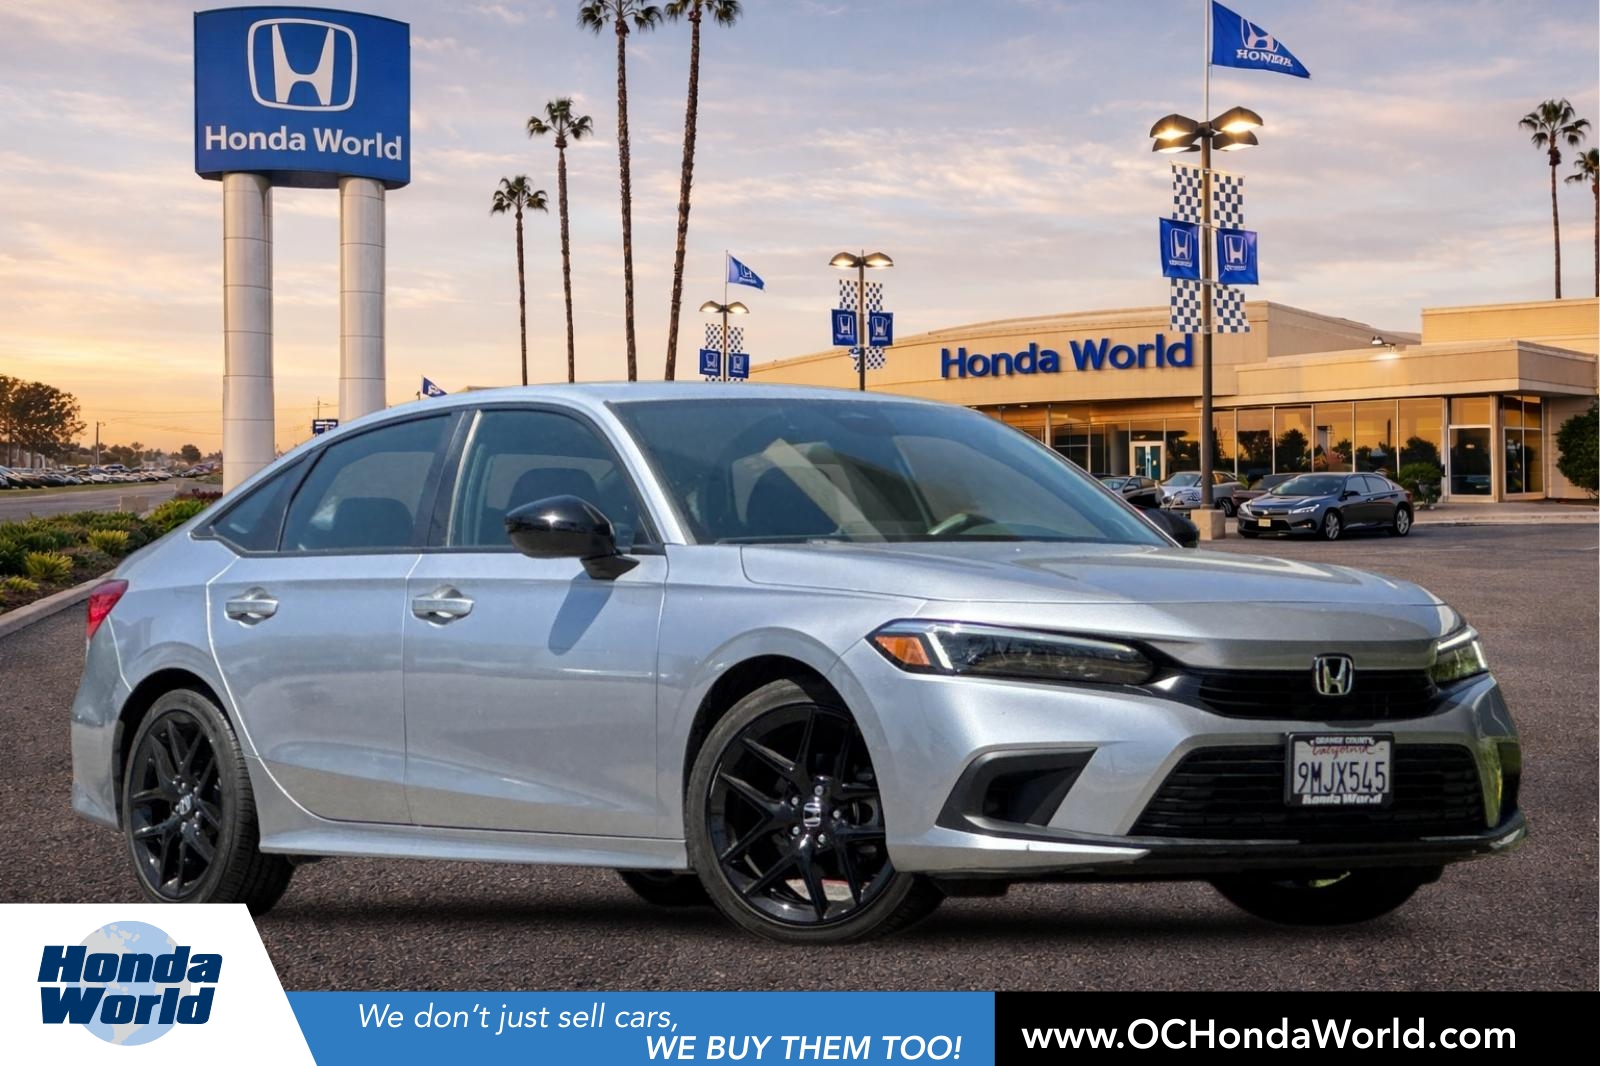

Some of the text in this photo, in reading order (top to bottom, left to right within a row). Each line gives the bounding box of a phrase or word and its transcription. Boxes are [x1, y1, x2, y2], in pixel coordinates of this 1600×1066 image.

[205, 125, 402, 160] Honda World
[941, 333, 1194, 378] Honda World
[1298, 761, 1386, 794] 9MJX545
[1302, 793, 1342, 805] Honda
